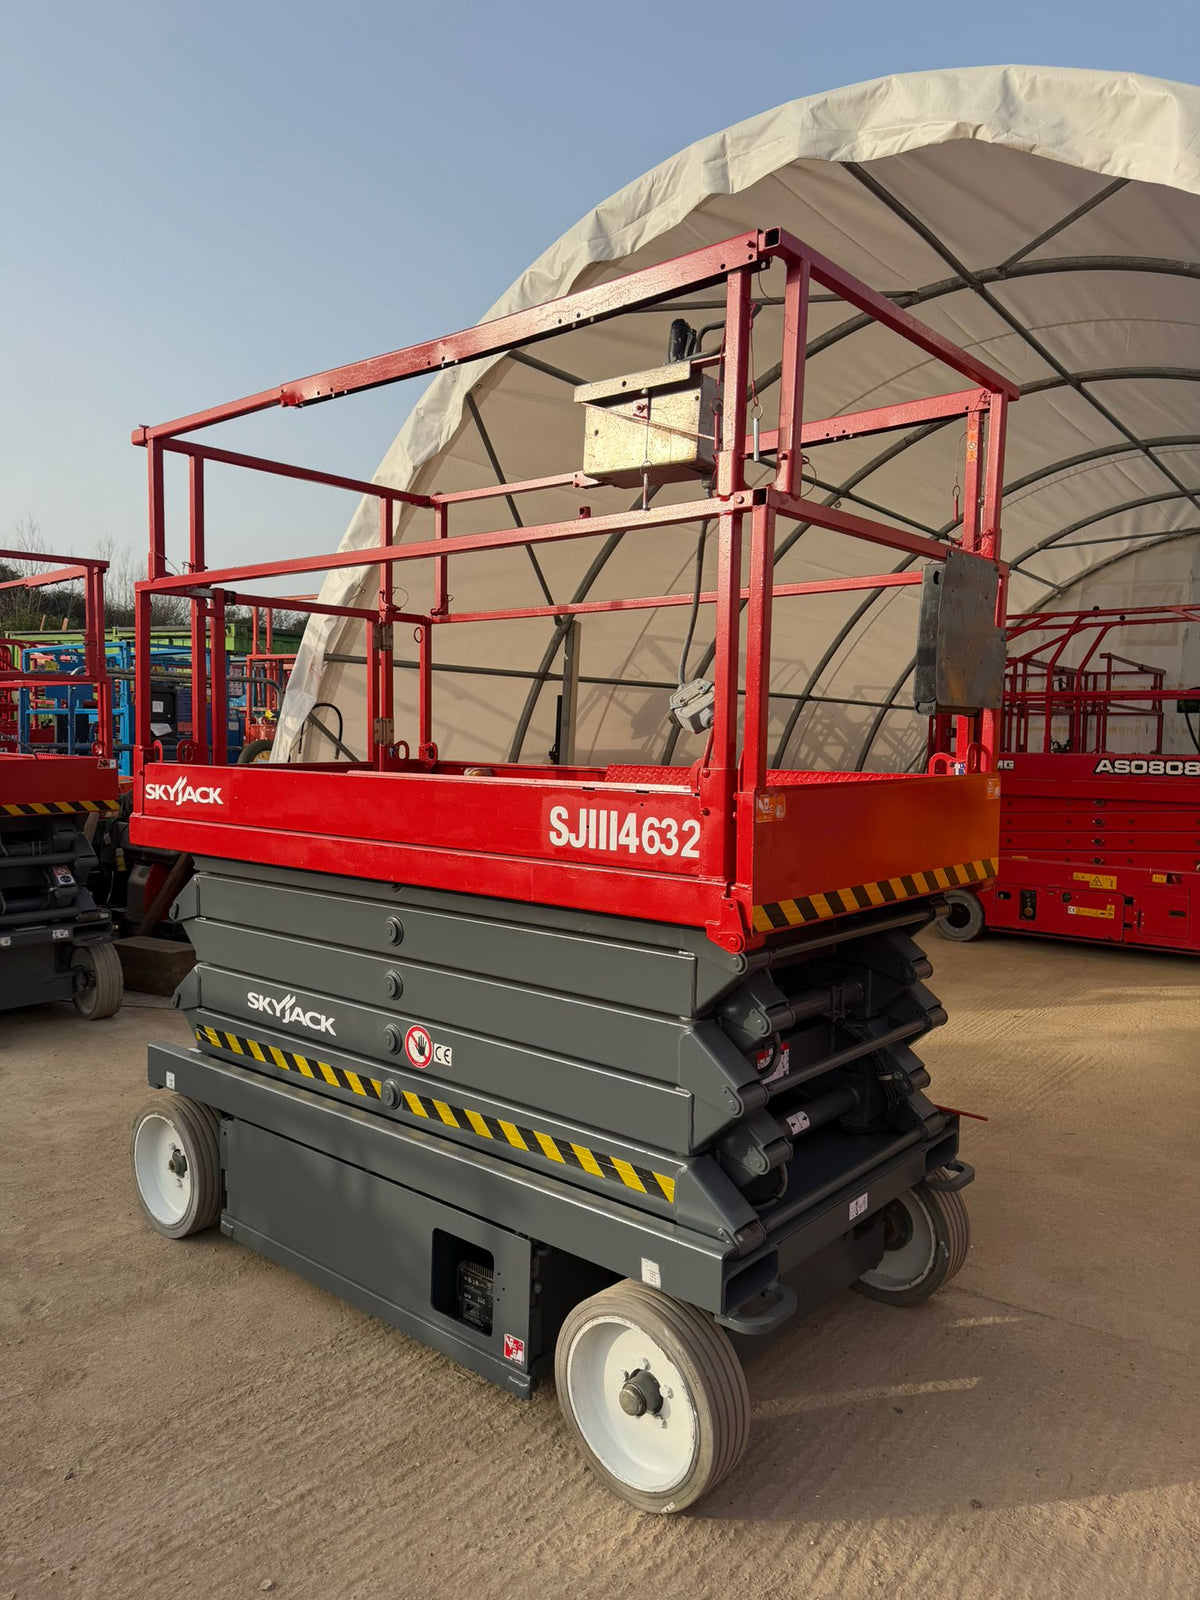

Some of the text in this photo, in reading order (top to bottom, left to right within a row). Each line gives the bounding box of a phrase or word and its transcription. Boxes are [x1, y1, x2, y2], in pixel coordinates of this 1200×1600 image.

[145, 775, 224, 806] SKYJACK
[247, 992, 337, 1037] SKYJACK
[435, 1045, 451, 1064] CE
